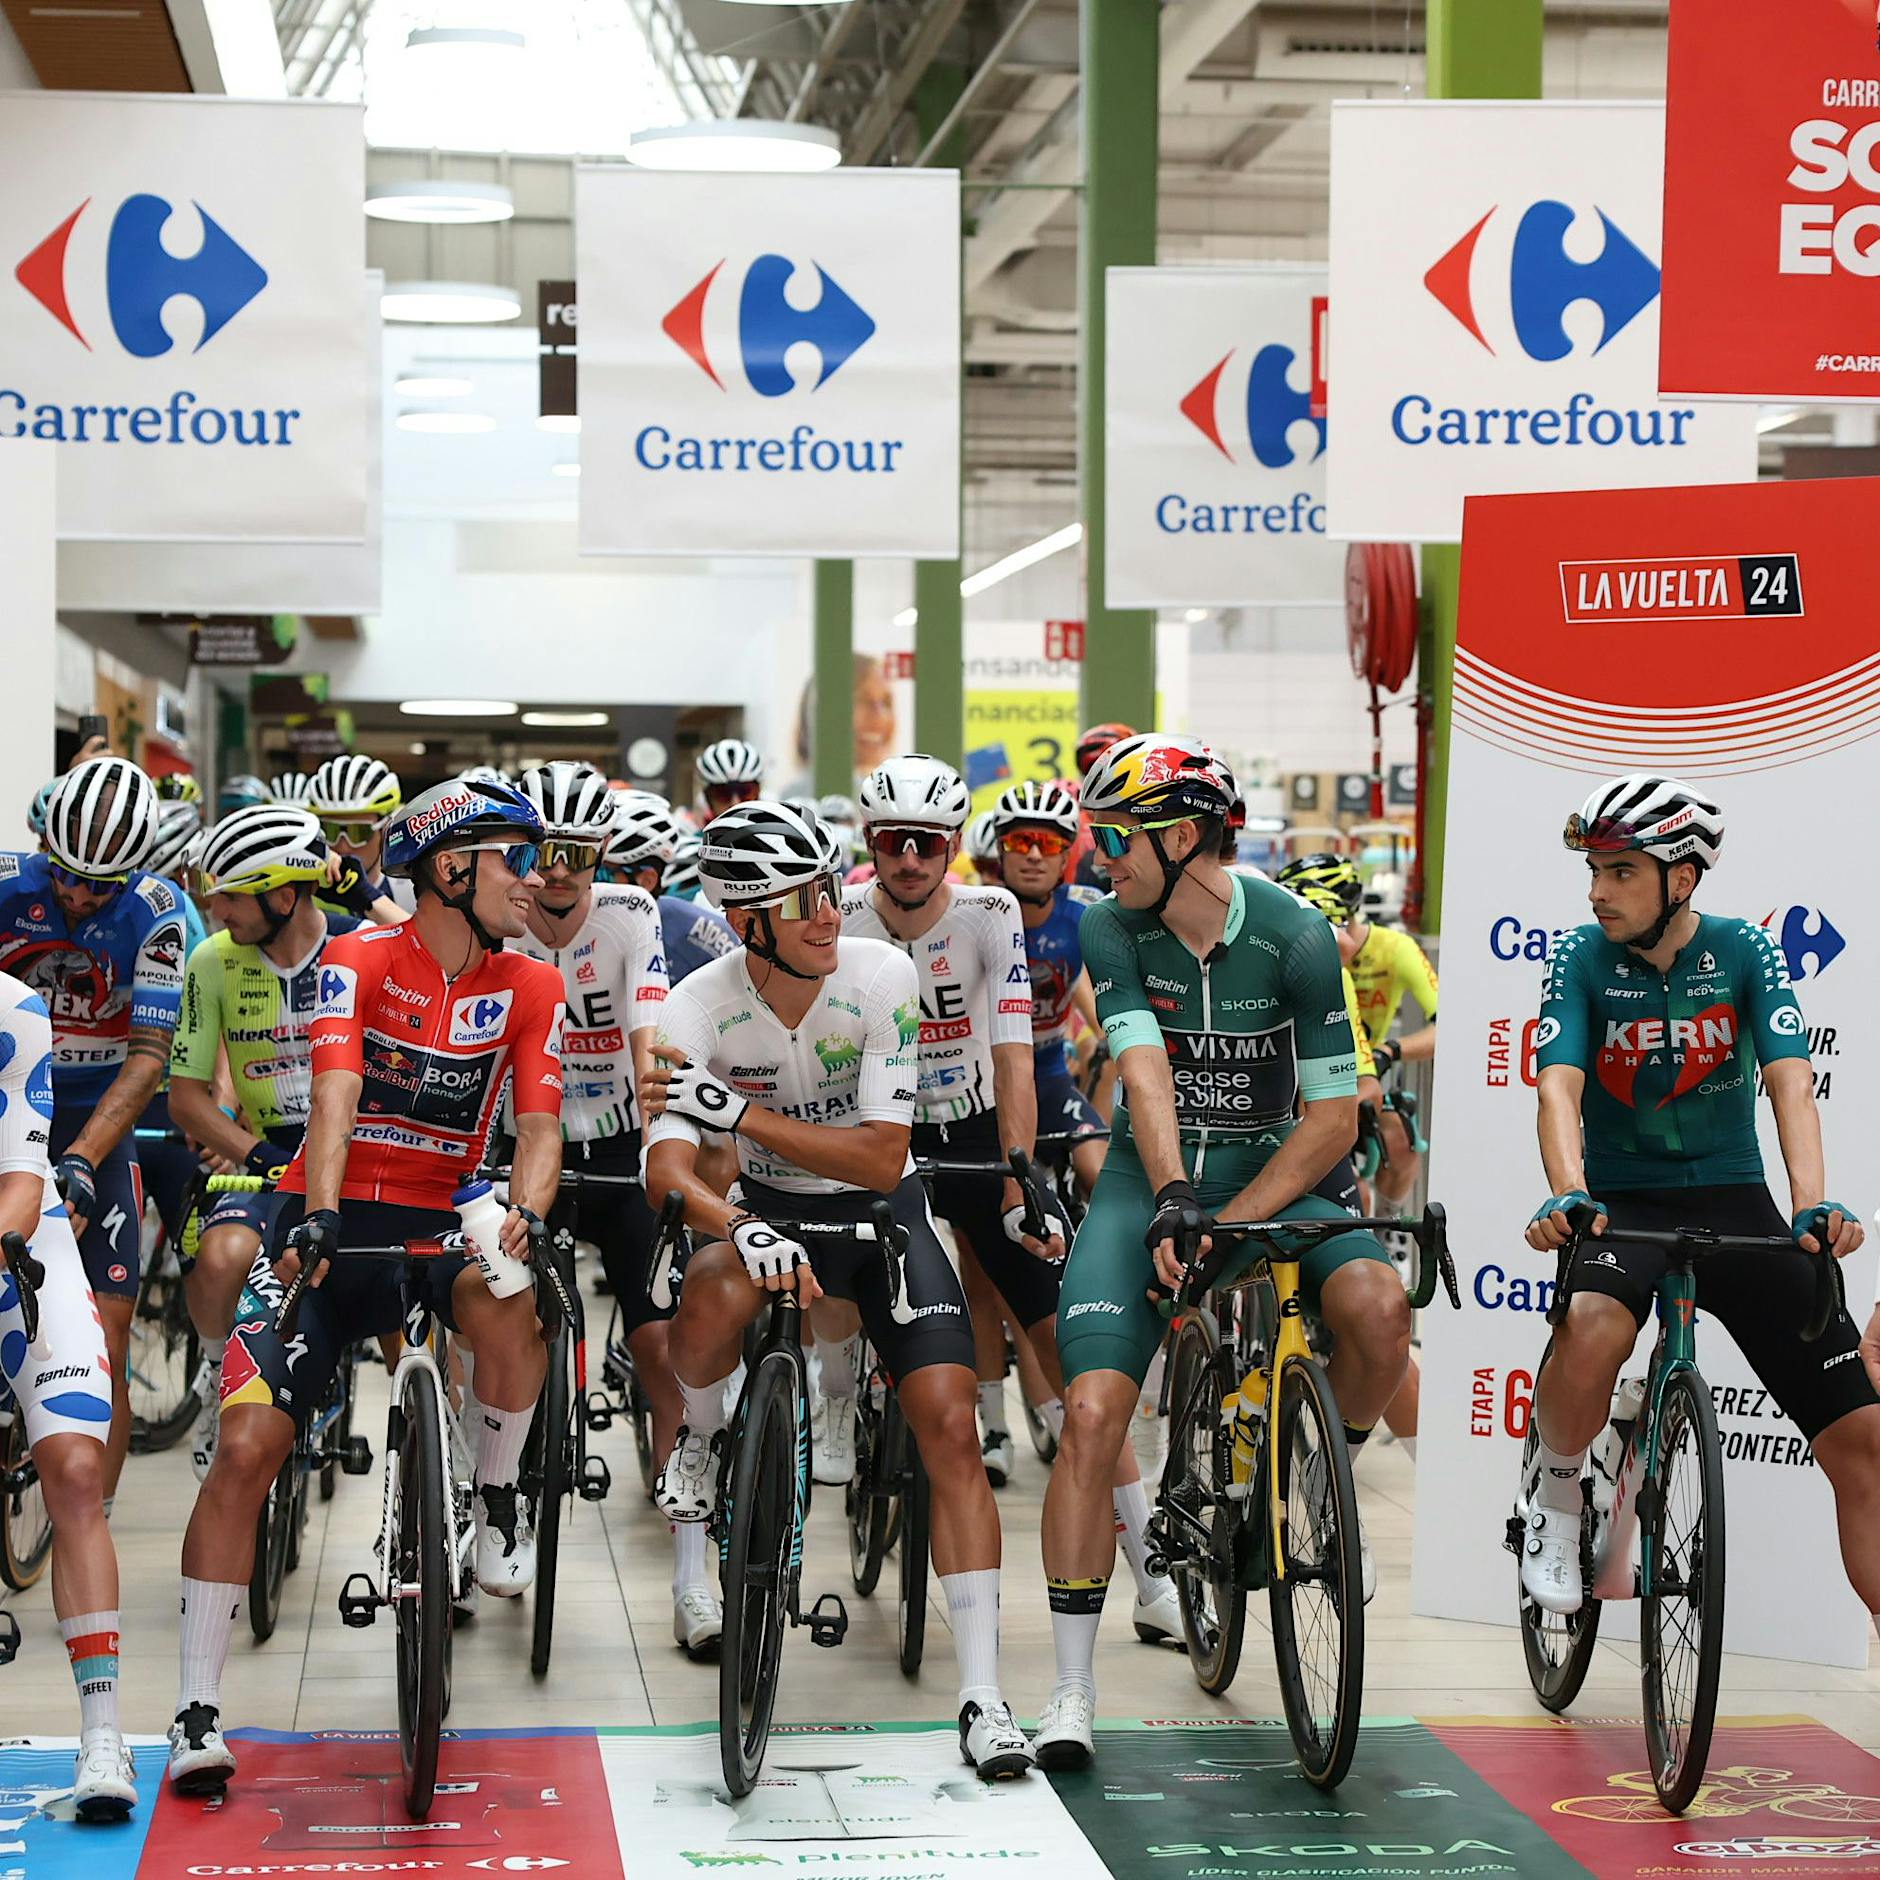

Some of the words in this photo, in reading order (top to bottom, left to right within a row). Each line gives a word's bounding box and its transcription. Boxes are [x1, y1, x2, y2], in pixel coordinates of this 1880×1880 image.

[0, 390, 300, 445] Carrefour
[1391, 393, 1694, 446] Carrefour
[635, 426, 902, 472] Carrefour
[1578, 573, 1612, 610] LA
[1619, 569, 1729, 609] VUELTA
[1750, 567, 1789, 605] 24
[406, 802, 440, 836] Red
[1130, 806, 1162, 814] GIRO
[1657, 809, 1694, 834] GIANT
[1669, 838, 1694, 856] KERN
[285, 857, 317, 868] uvex
[724, 882, 772, 891] RUDY
[597, 894, 654, 915] presight
[954, 896, 1011, 914] presight
[383, 976, 432, 1008] Santini
[1145, 975, 1189, 995] Santini
[1605, 987, 1648, 999] GIANT
[827, 997, 862, 1018] plenitude
[1221, 997, 1280, 1011] SKODA
[718, 1011, 752, 1036] plenitude
[1605, 1017, 1735, 1051] KERN
[455, 1028, 500, 1041] Carrefour
[1187, 1036, 1278, 1060] VISMA
[1487, 1018, 1510, 1087] ETAPA
[1604, 1051, 1735, 1066] PHARMA
[425, 1067, 482, 1089] BORA
[729, 1066, 779, 1077] Santini
[1698, 1074, 1744, 1095] Oxicol
[1065, 1300, 1125, 1320] Santini
[34, 1365, 91, 1388] Santini
[1471, 1367, 1495, 1437] ETAPA
[1504, 1369, 1533, 1438] 6
[82, 1681, 112, 1697] DEFEET
[797, 1849, 1041, 1863] plenitude
[1146, 1839, 1516, 1858] SKODA
[187, 1860, 445, 1876] Carrefour
